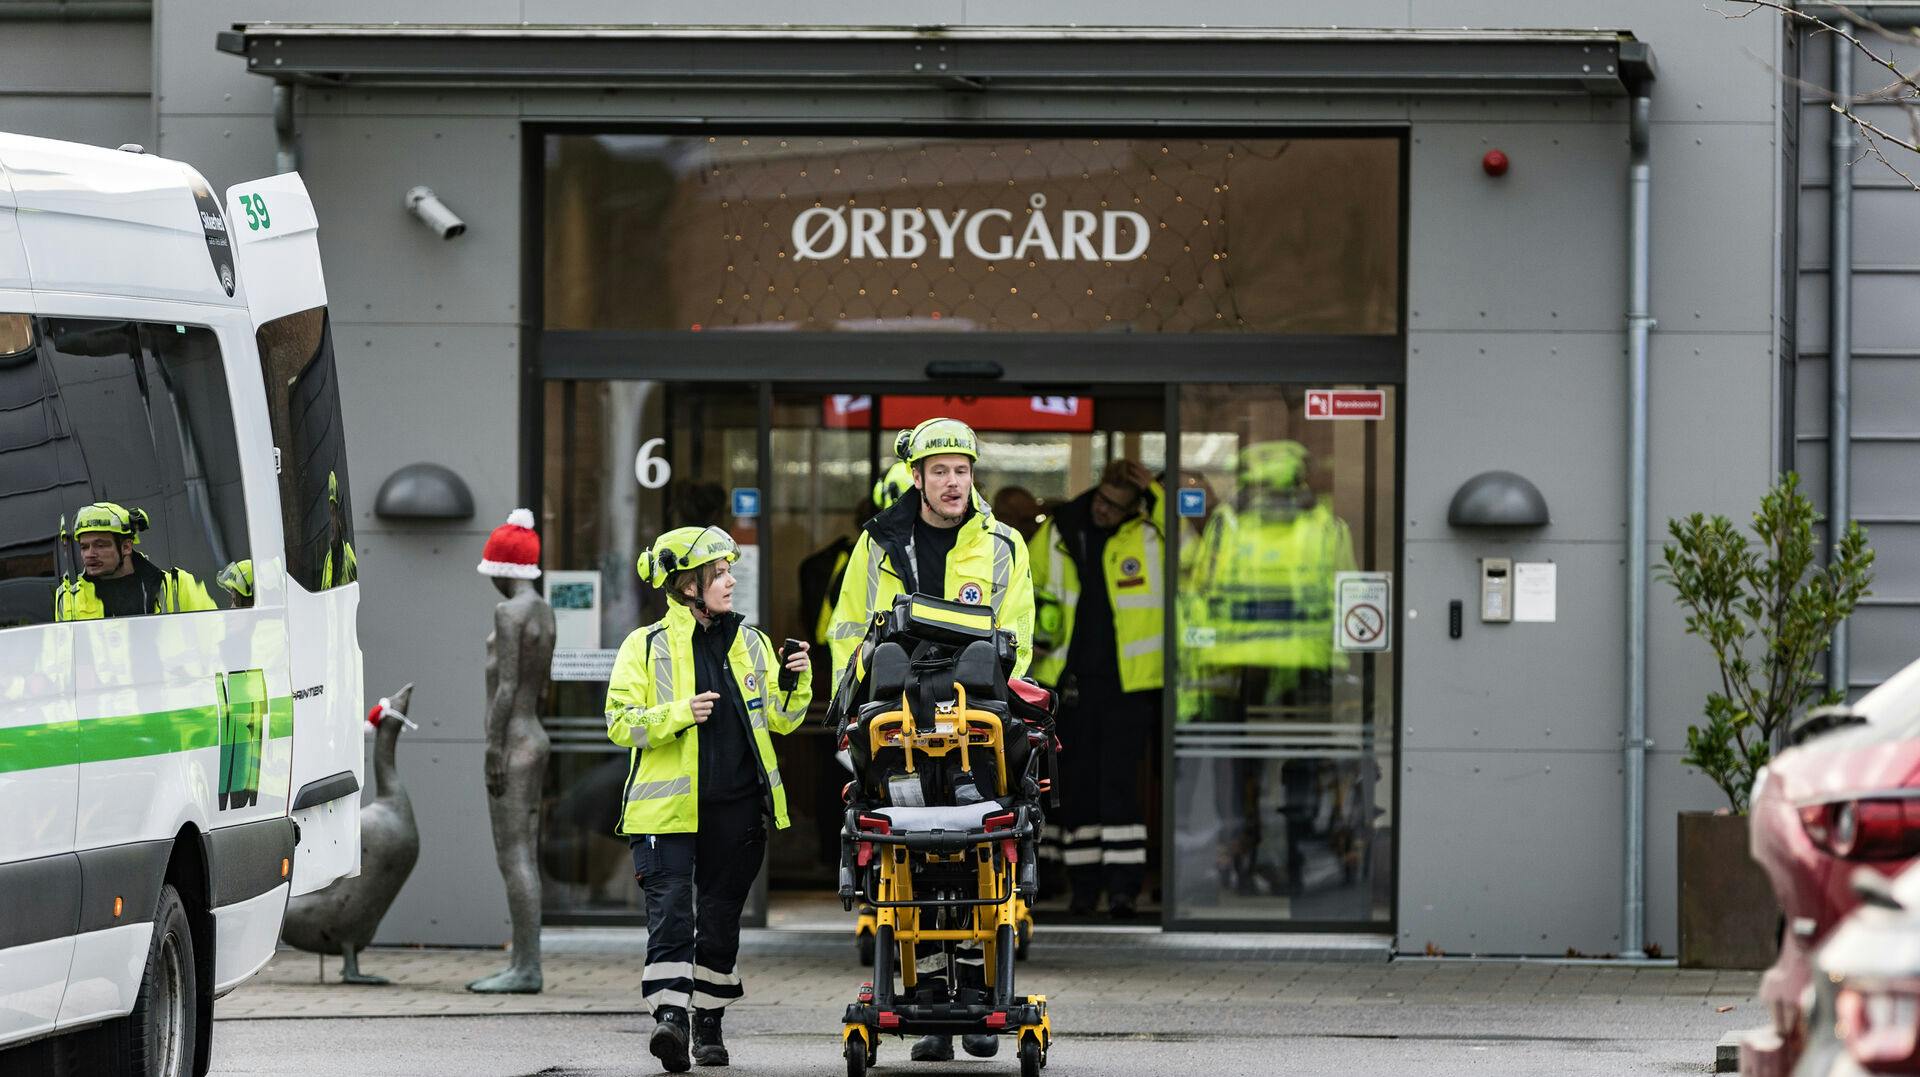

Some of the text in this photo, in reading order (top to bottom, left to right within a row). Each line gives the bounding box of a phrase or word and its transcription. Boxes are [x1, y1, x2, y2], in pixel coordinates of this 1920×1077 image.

[239, 193, 271, 231] 39
[791, 192, 1151, 261] ØRBYGÅRD
[634, 437, 672, 489] 6
